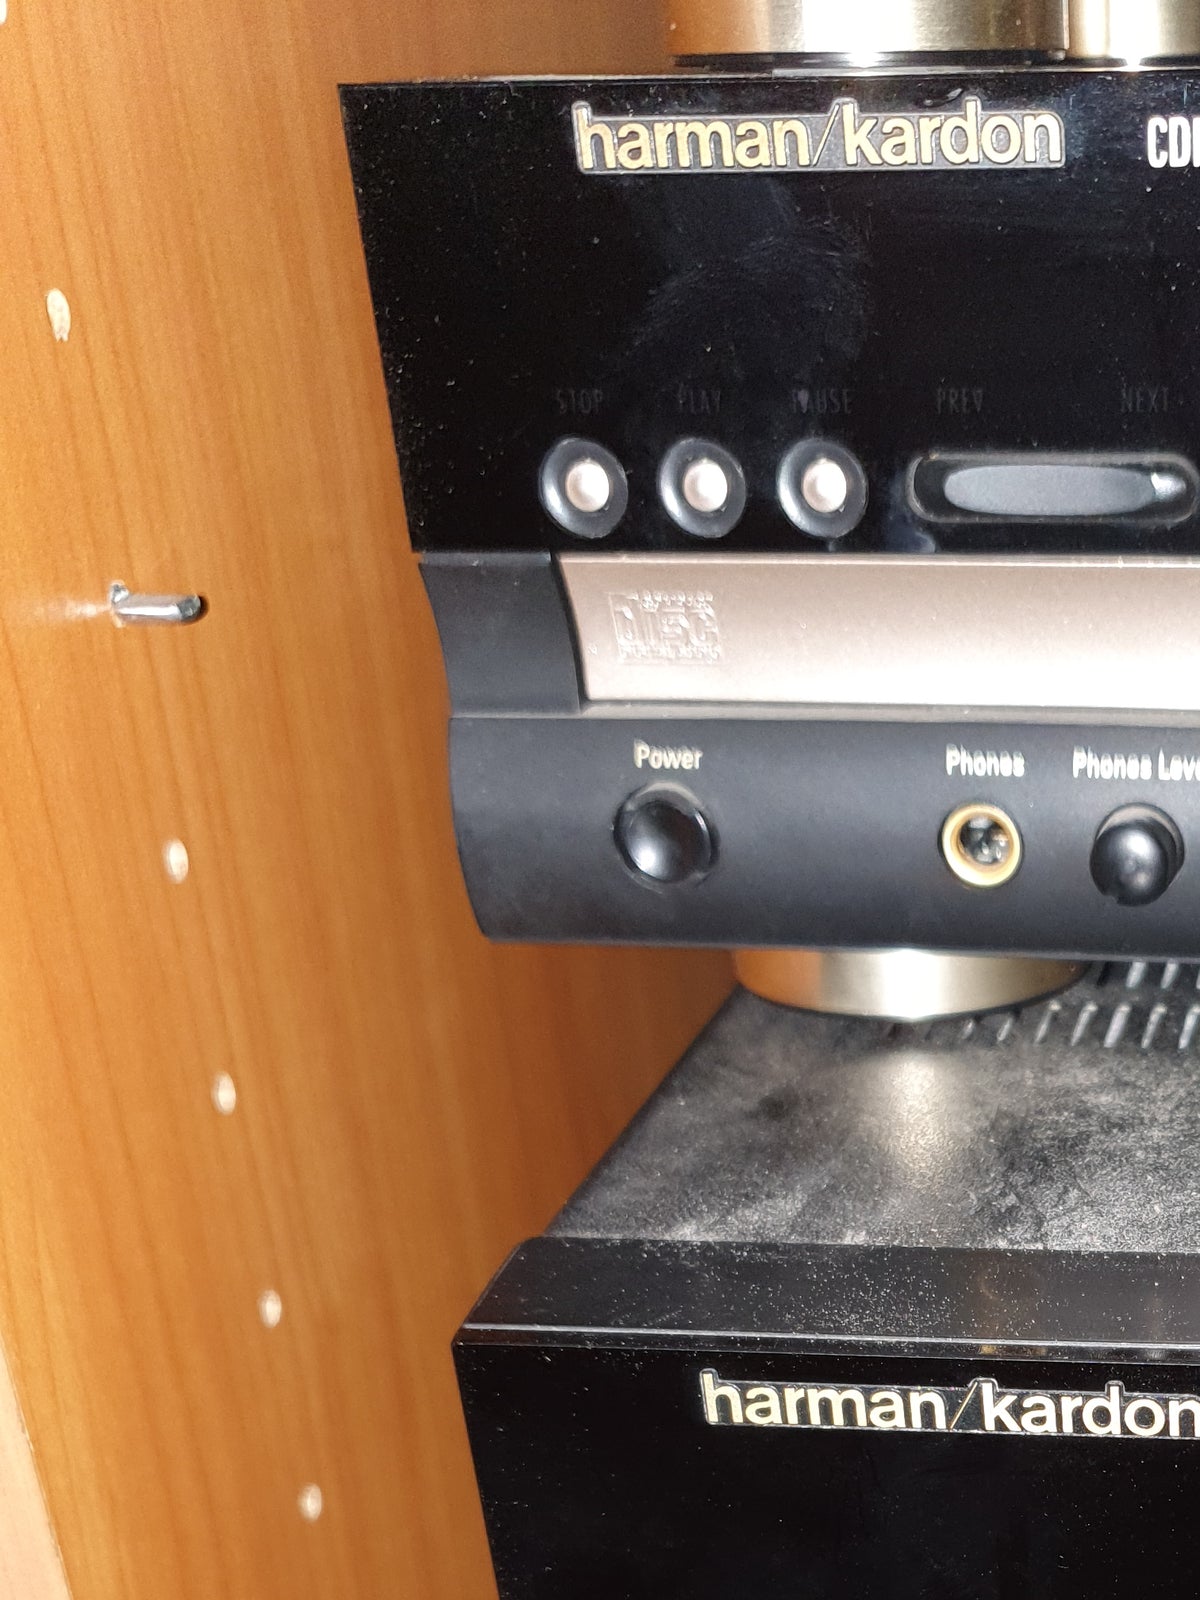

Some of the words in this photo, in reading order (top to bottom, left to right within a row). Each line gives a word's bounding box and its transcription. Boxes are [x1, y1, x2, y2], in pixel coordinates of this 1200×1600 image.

[575, 101, 1062, 170] harman/kardon
[632, 740, 704, 771] Power
[945, 744, 1026, 779] Phones
[1072, 747, 1151, 783] Phones
